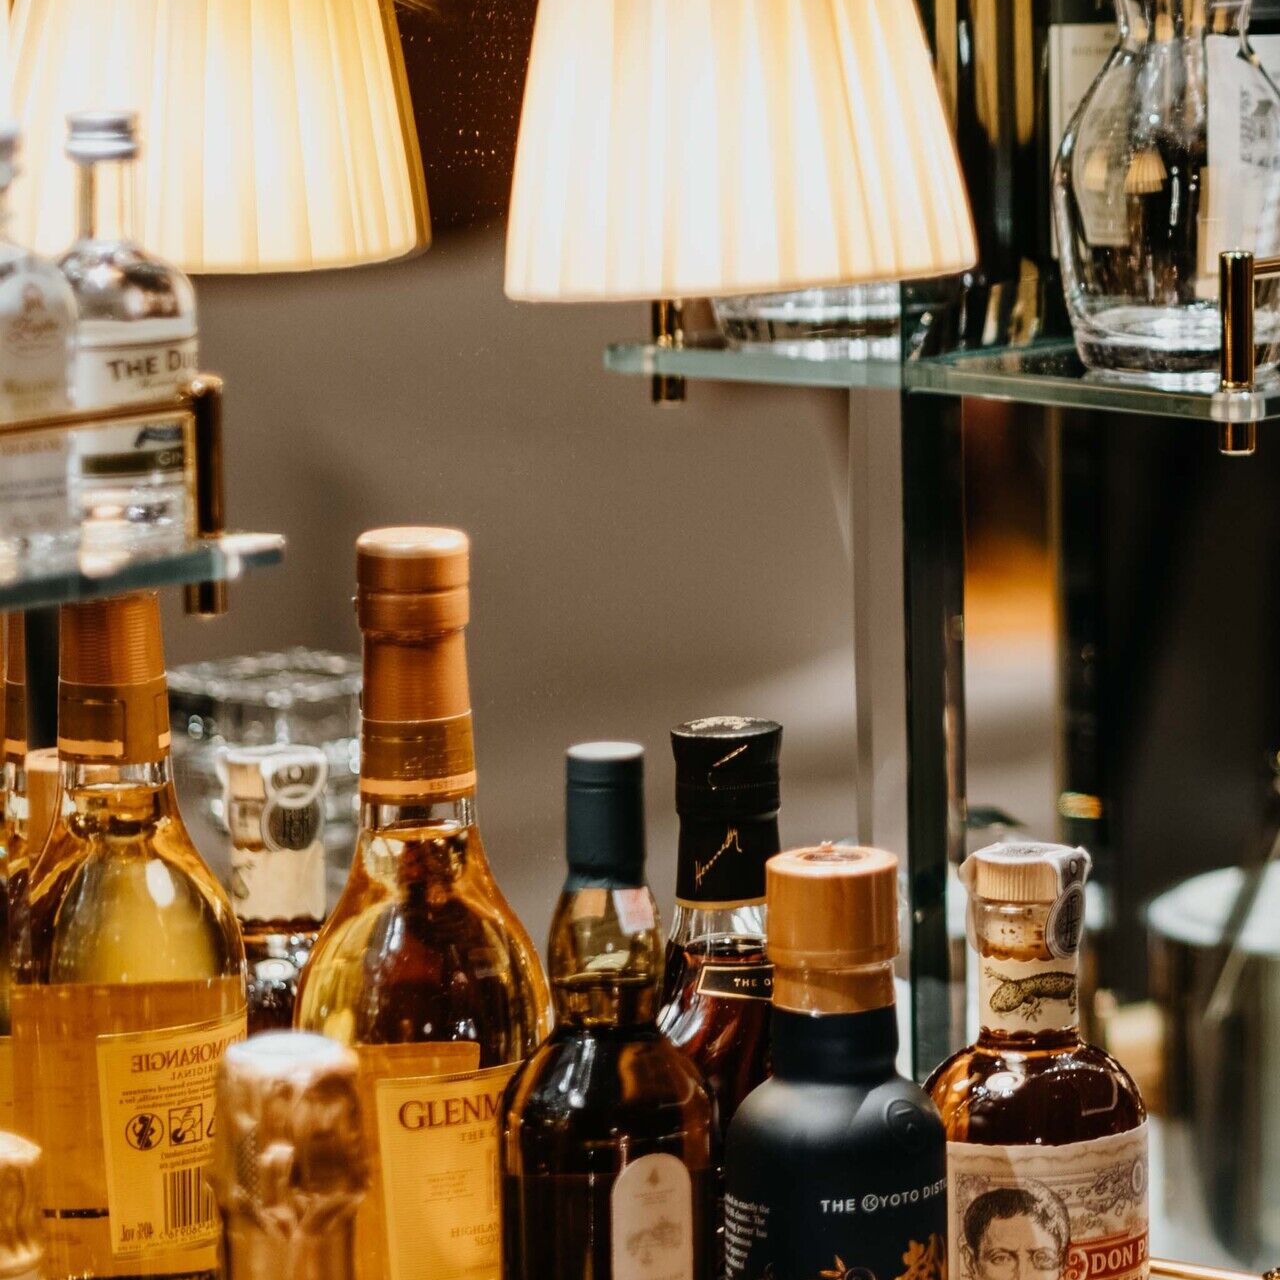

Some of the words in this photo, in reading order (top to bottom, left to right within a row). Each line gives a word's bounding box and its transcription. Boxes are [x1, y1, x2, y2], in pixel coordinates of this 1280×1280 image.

[106, 356, 159, 382] THE
[733, 977, 758, 988] THE
[820, 1198, 856, 1214] THE
[1091, 1245, 1134, 1275] DON
